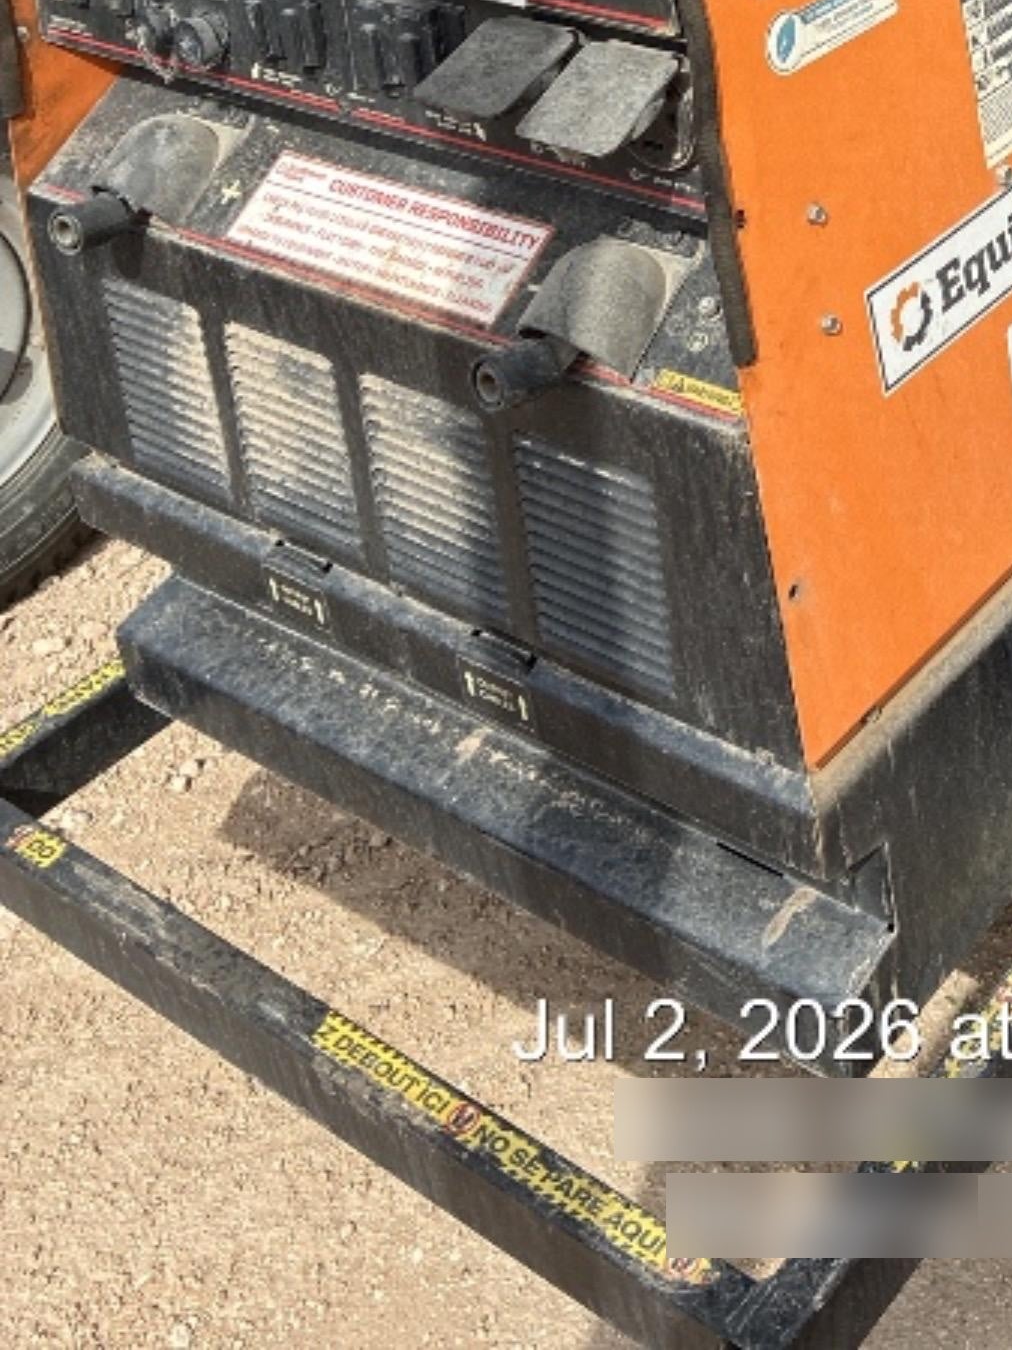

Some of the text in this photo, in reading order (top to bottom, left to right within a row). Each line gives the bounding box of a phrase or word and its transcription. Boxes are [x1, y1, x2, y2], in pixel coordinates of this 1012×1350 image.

[329, 179, 408, 211] CUSTOMER
[408, 201, 541, 248] RESPONSIBILITY
[333, 1034, 421, 1093] DEBOUT
[473, 1124, 511, 1153] NO
[509, 1148, 542, 1177] SE
